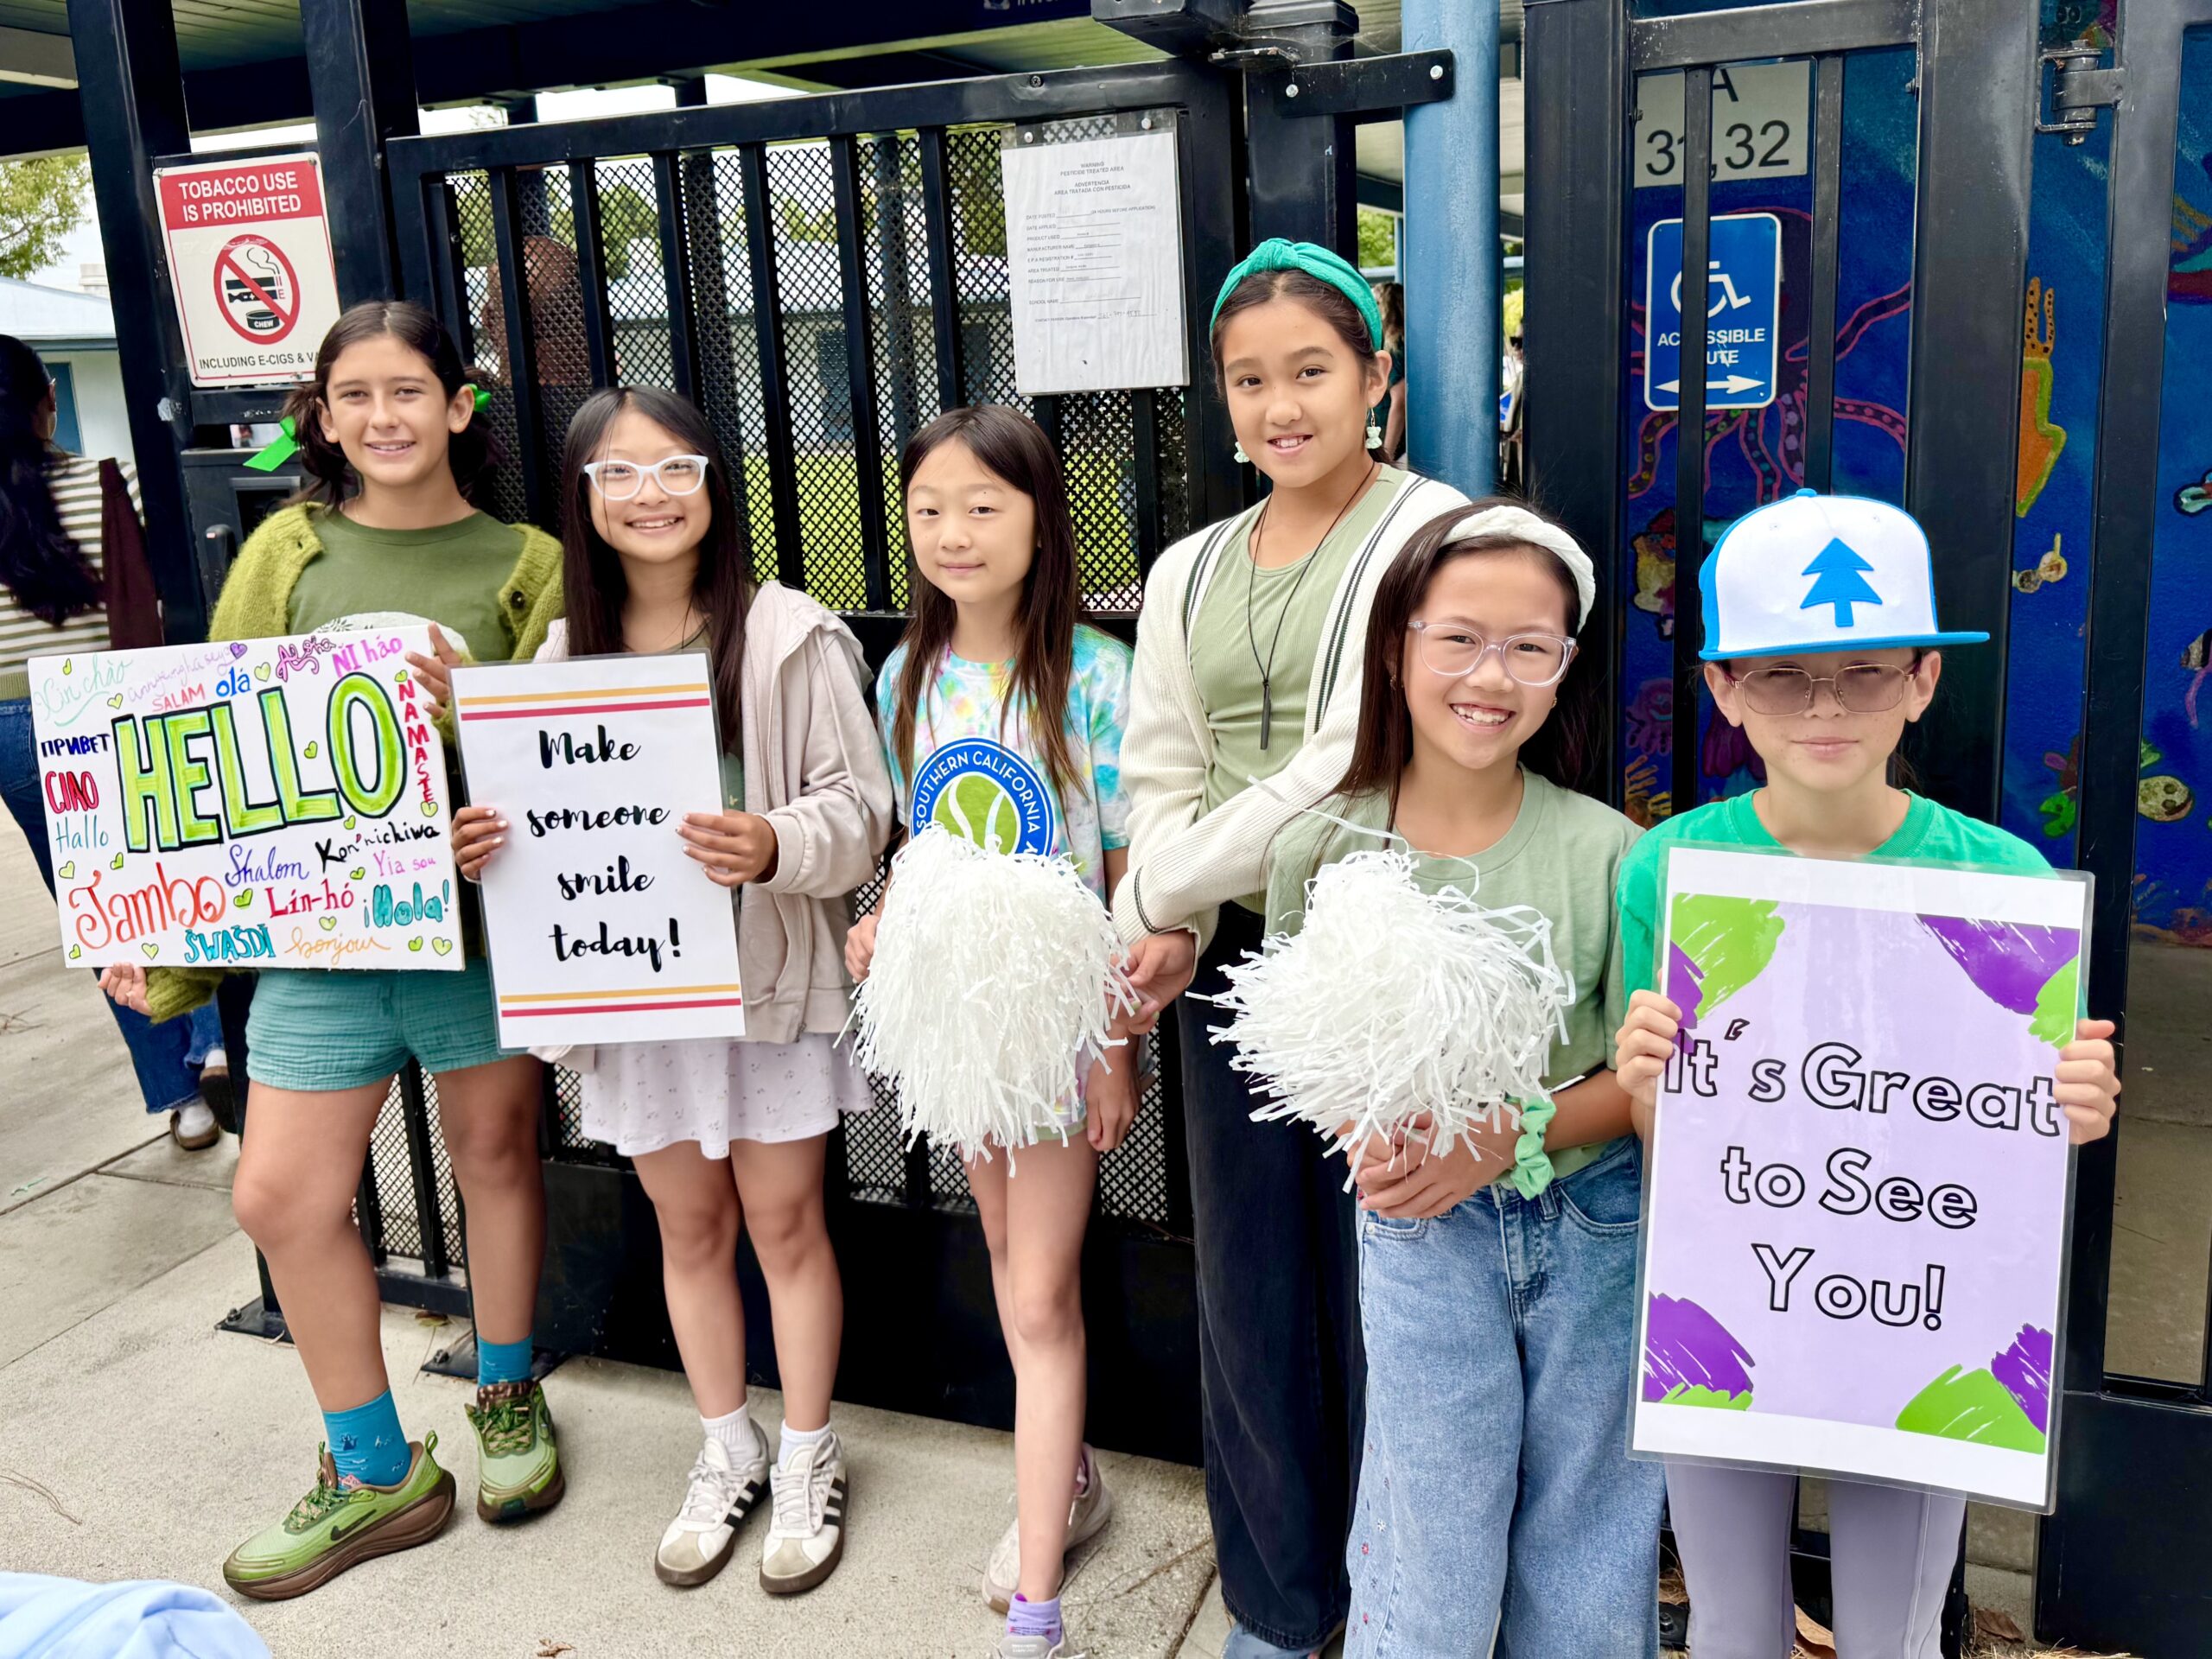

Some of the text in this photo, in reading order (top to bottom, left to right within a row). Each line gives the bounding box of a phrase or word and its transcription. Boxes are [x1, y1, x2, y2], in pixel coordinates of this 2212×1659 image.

[178, 171, 298, 200] TOBACCO USE
[1074, 179, 1110, 188] ADVERTENCIA
[182, 194, 302, 222] IS PROHIBITED
[253, 319, 275, 329] CHEW
[1657, 327, 1766, 347] ACSSIBLE
[199, 353, 257, 370] INCLUDING
[258, 352, 295, 366] E-CIGS
[296, 351, 308, 365] &
[1706, 349, 1739, 365] UTE
[275, 634, 337, 683] Aloha
[152, 682, 206, 712] SALAM
[215, 665, 251, 697] olá
[111, 671, 408, 854] HELLO
[398, 678, 435, 804] NAMASTE
[537, 724, 642, 769] Make
[44, 770, 100, 815] CIAO
[916, 750, 1041, 834] SOUTHERN CALIFORNIA
[55, 814, 110, 854] Hallo
[525, 804, 671, 838] someone
[225, 843, 310, 887] Shalom
[372, 849, 437, 877] Yia sou
[556, 855, 656, 901] smile
[68, 861, 226, 950] Jambo
[548, 917, 682, 974] today!
[1801, 1040, 2062, 1137] Great
[1719, 1145, 1979, 1230] to See
[1751, 1242, 1946, 1332] You!
